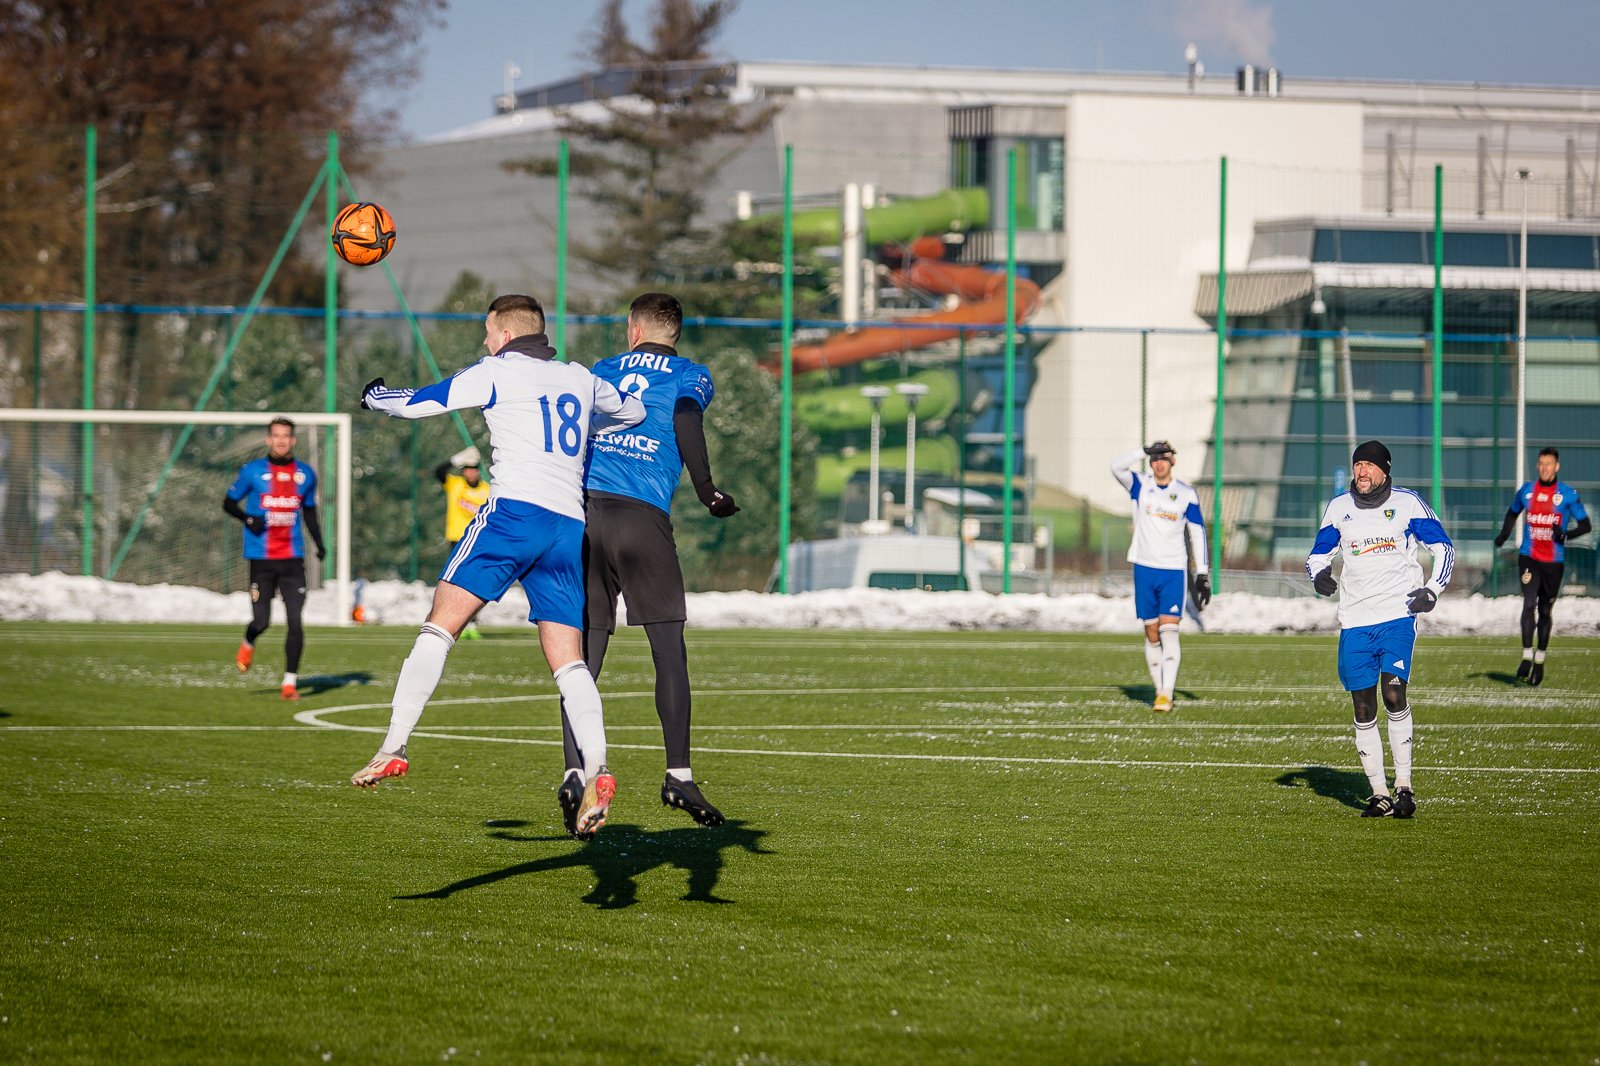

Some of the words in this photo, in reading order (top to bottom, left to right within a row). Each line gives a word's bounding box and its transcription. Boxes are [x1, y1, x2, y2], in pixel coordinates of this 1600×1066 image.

[619, 353, 673, 374] TORIL
[537, 392, 582, 457] 18
[1363, 536, 1395, 547] JELENIA
